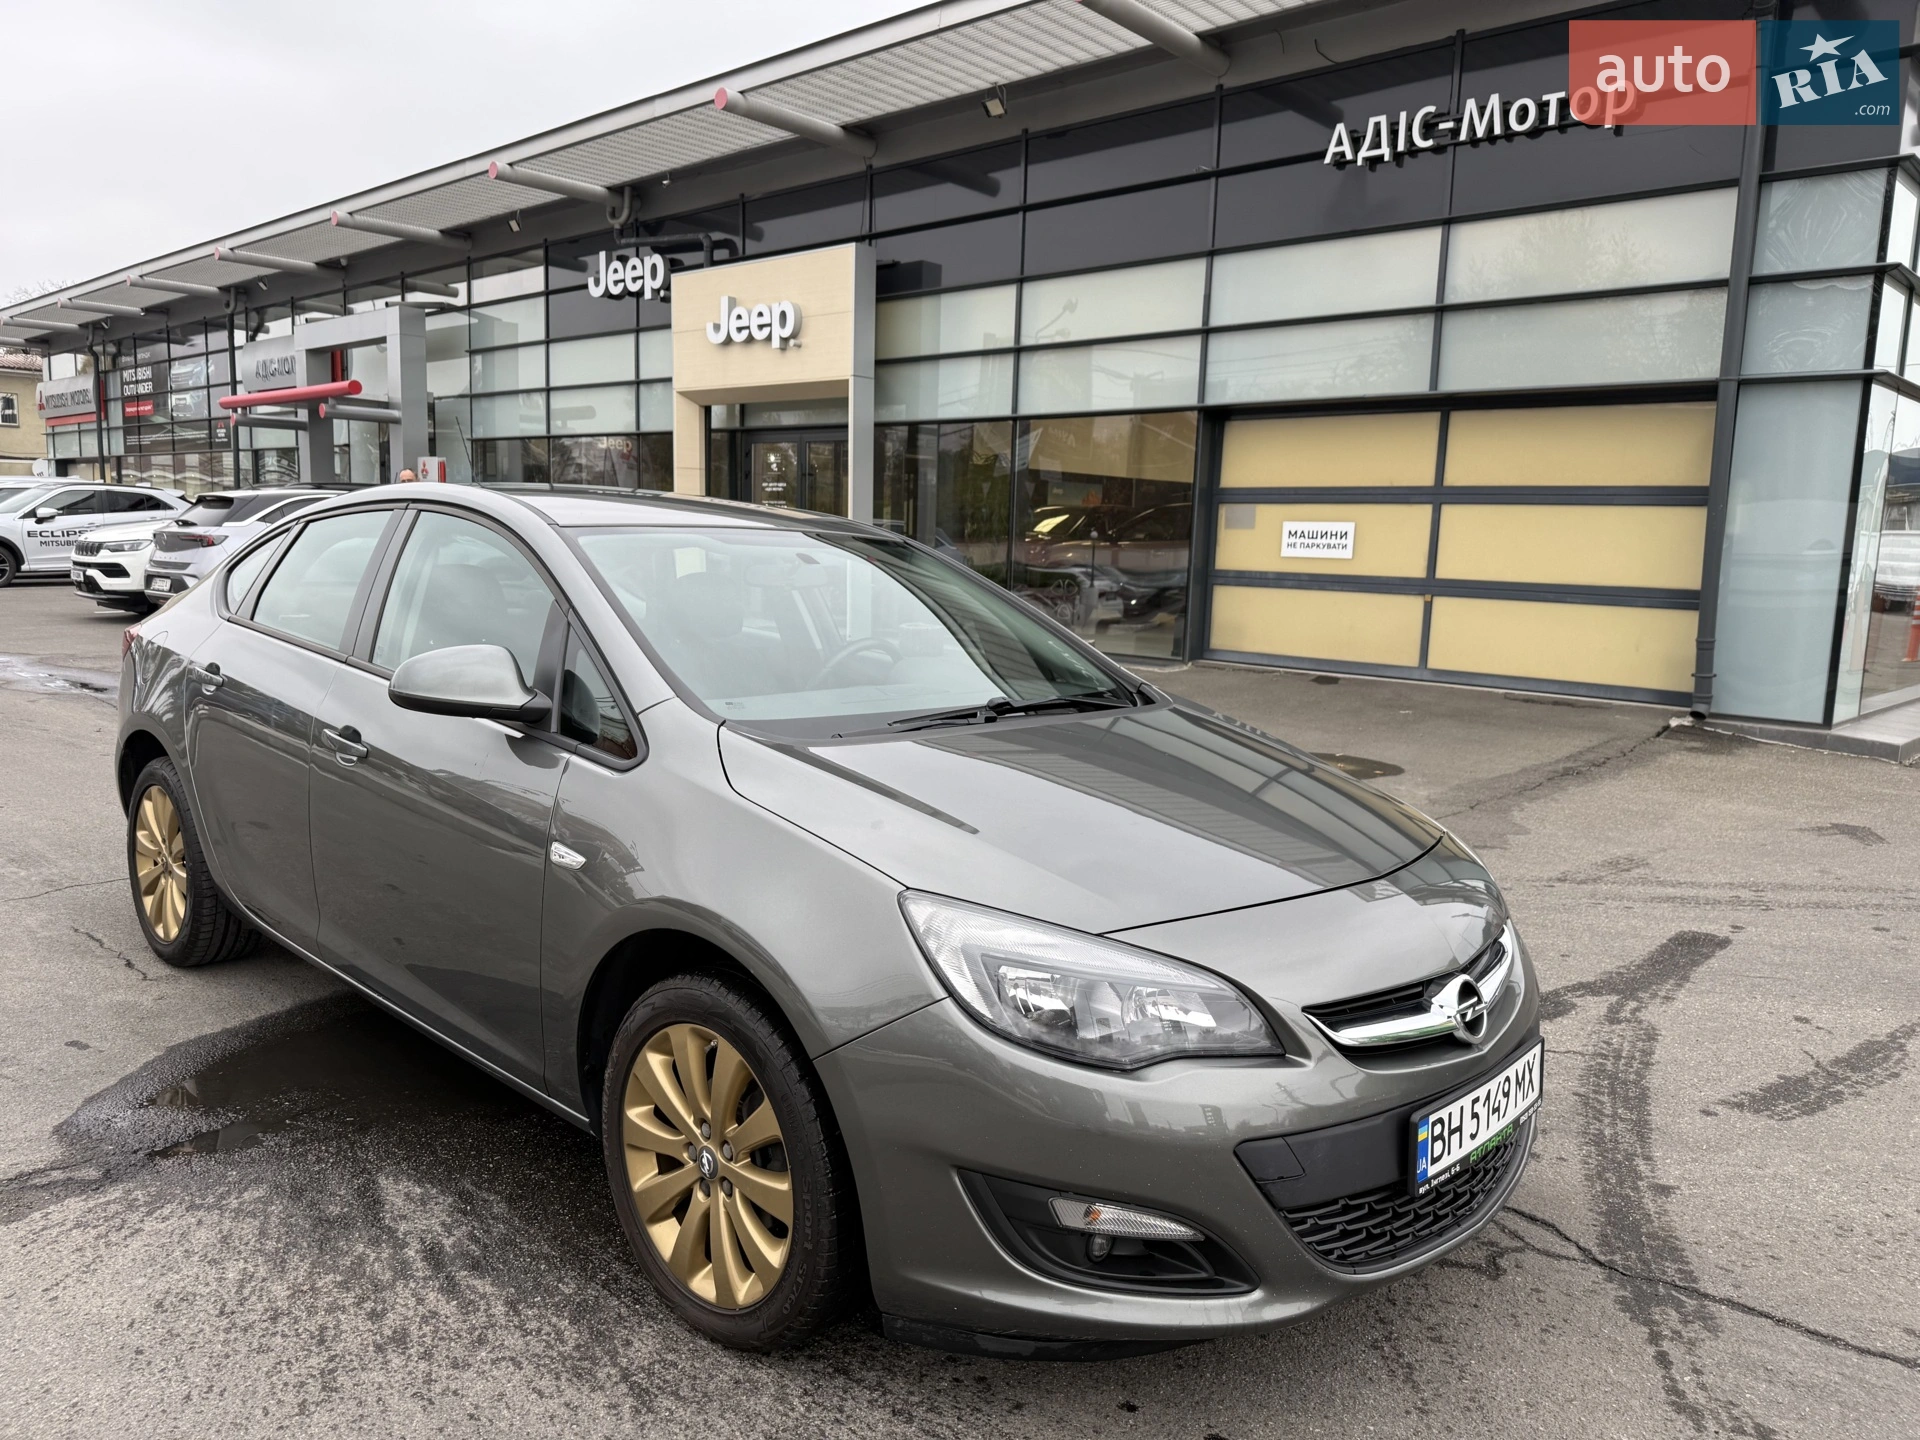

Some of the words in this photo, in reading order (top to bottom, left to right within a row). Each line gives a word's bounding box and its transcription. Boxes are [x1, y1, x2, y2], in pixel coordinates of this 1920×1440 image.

[587, 250, 668, 300] Jeep
[706, 295, 799, 350] Jeep
[1287, 541, 1297, 549] НЕ
[1299, 542, 1348, 550] ПАРКУВАТИ
[1288, 530, 1348, 540] МАШИНИ
[1469, 1075, 1511, 1141] 5149
